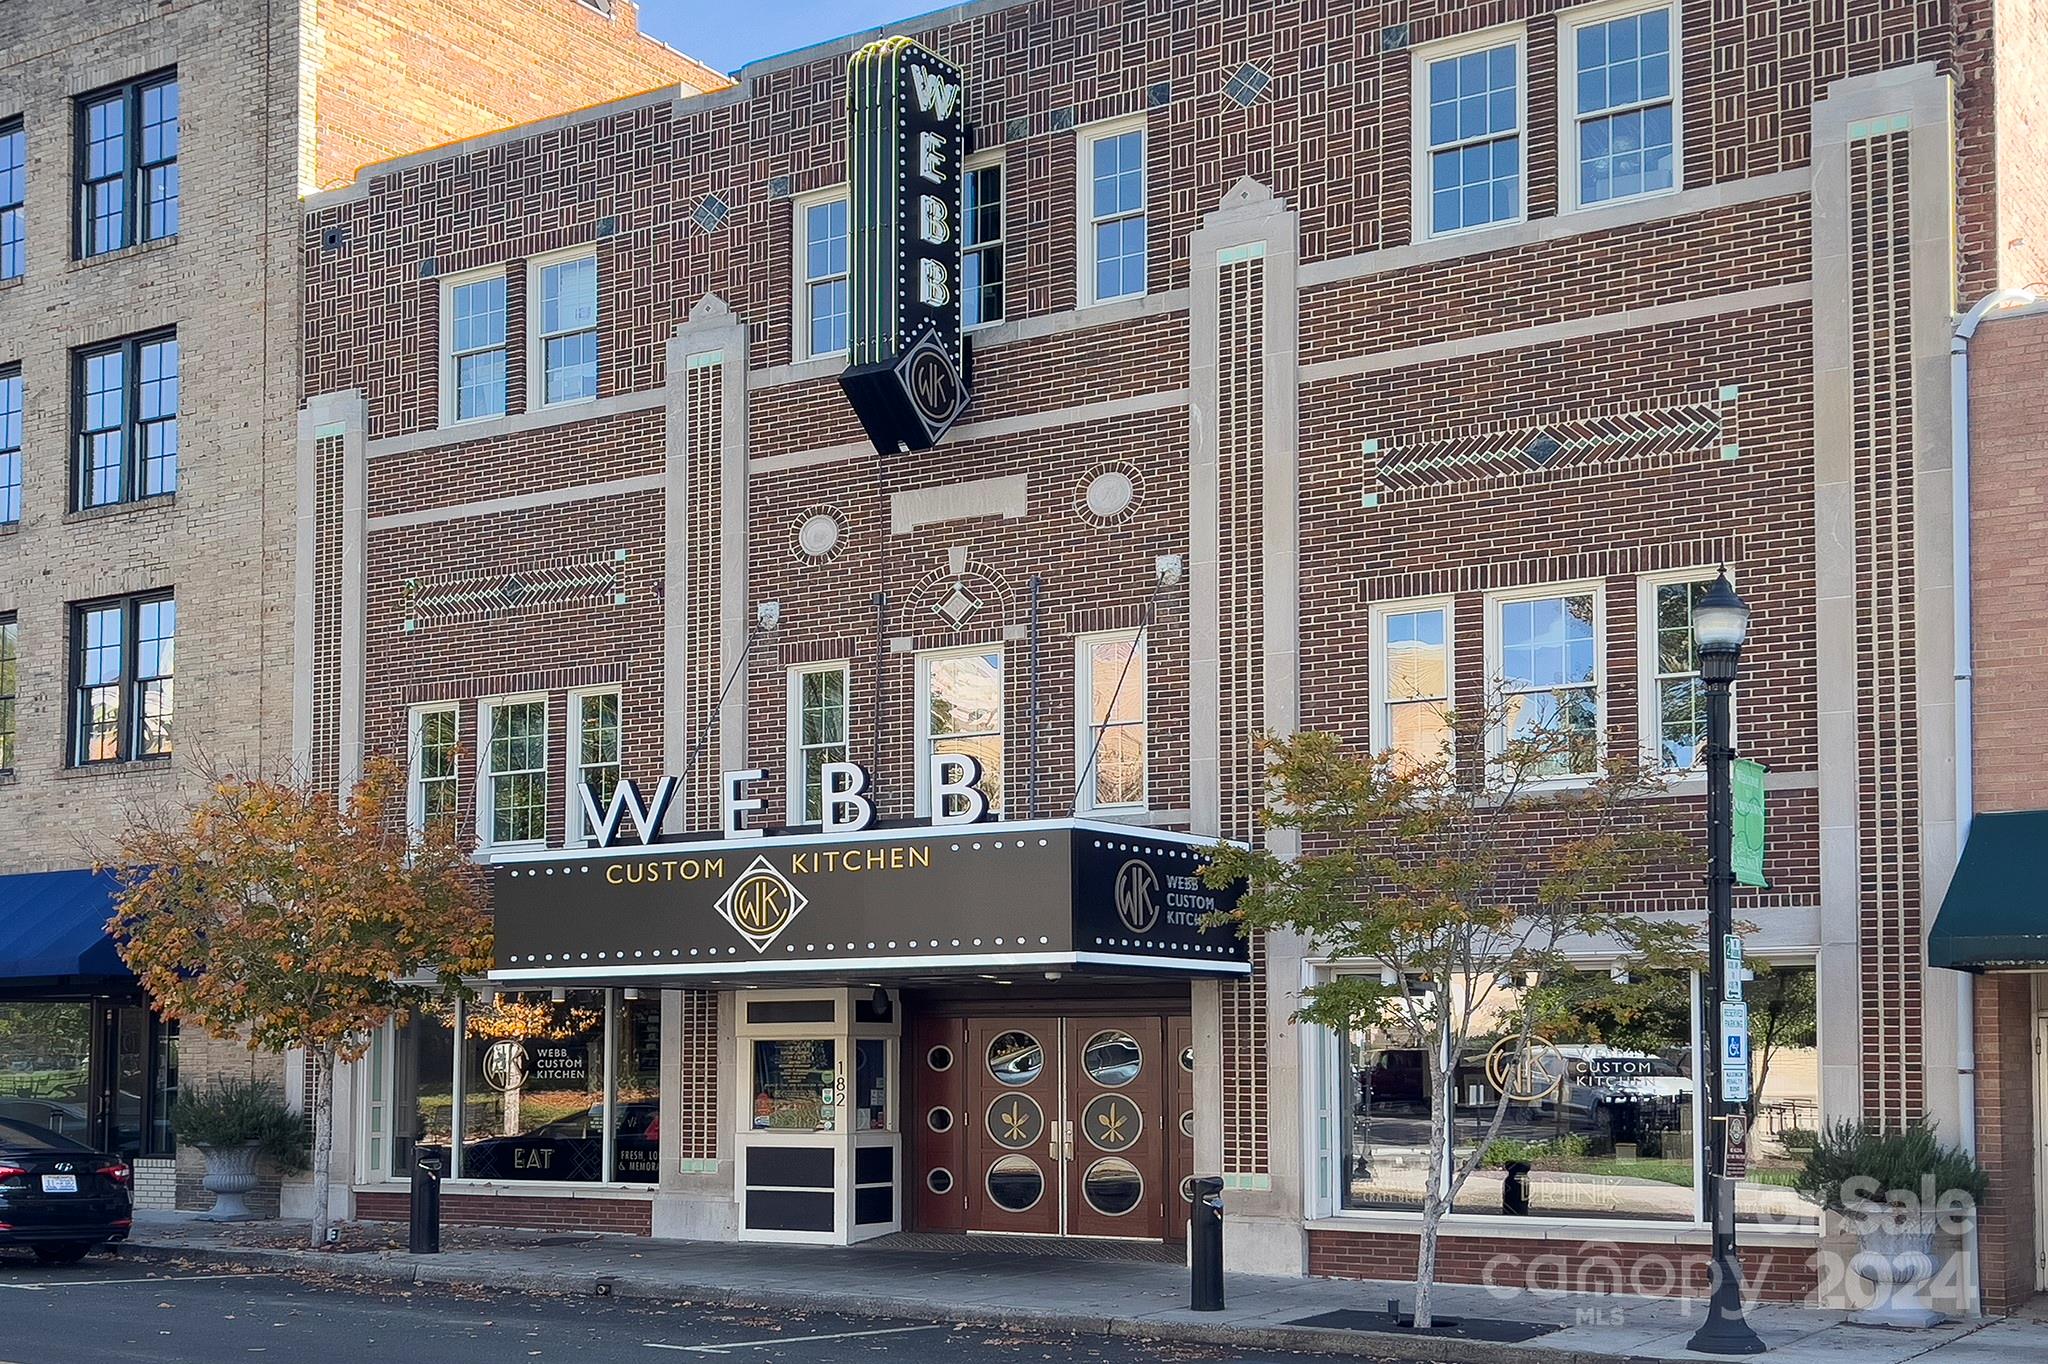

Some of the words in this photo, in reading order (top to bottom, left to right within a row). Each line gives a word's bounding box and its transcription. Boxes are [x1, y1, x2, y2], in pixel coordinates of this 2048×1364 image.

[910, 63, 960, 307] WEBB
[577, 753, 989, 848] WEBB
[605, 857, 724, 885] CUSTOM
[791, 846, 931, 875] KITCHEN
[1166, 874, 1199, 891] WEBB
[1166, 892, 1215, 910] CUSTOM
[536, 1048, 567, 1058] WEBB
[536, 1059, 583, 1069] CUSTOM
[1576, 1061, 1652, 1074] CUSTOM
[536, 1070, 586, 1079] KITCHEN
[836, 1060, 846, 1107] 182
[514, 1148, 554, 1169] EAT
